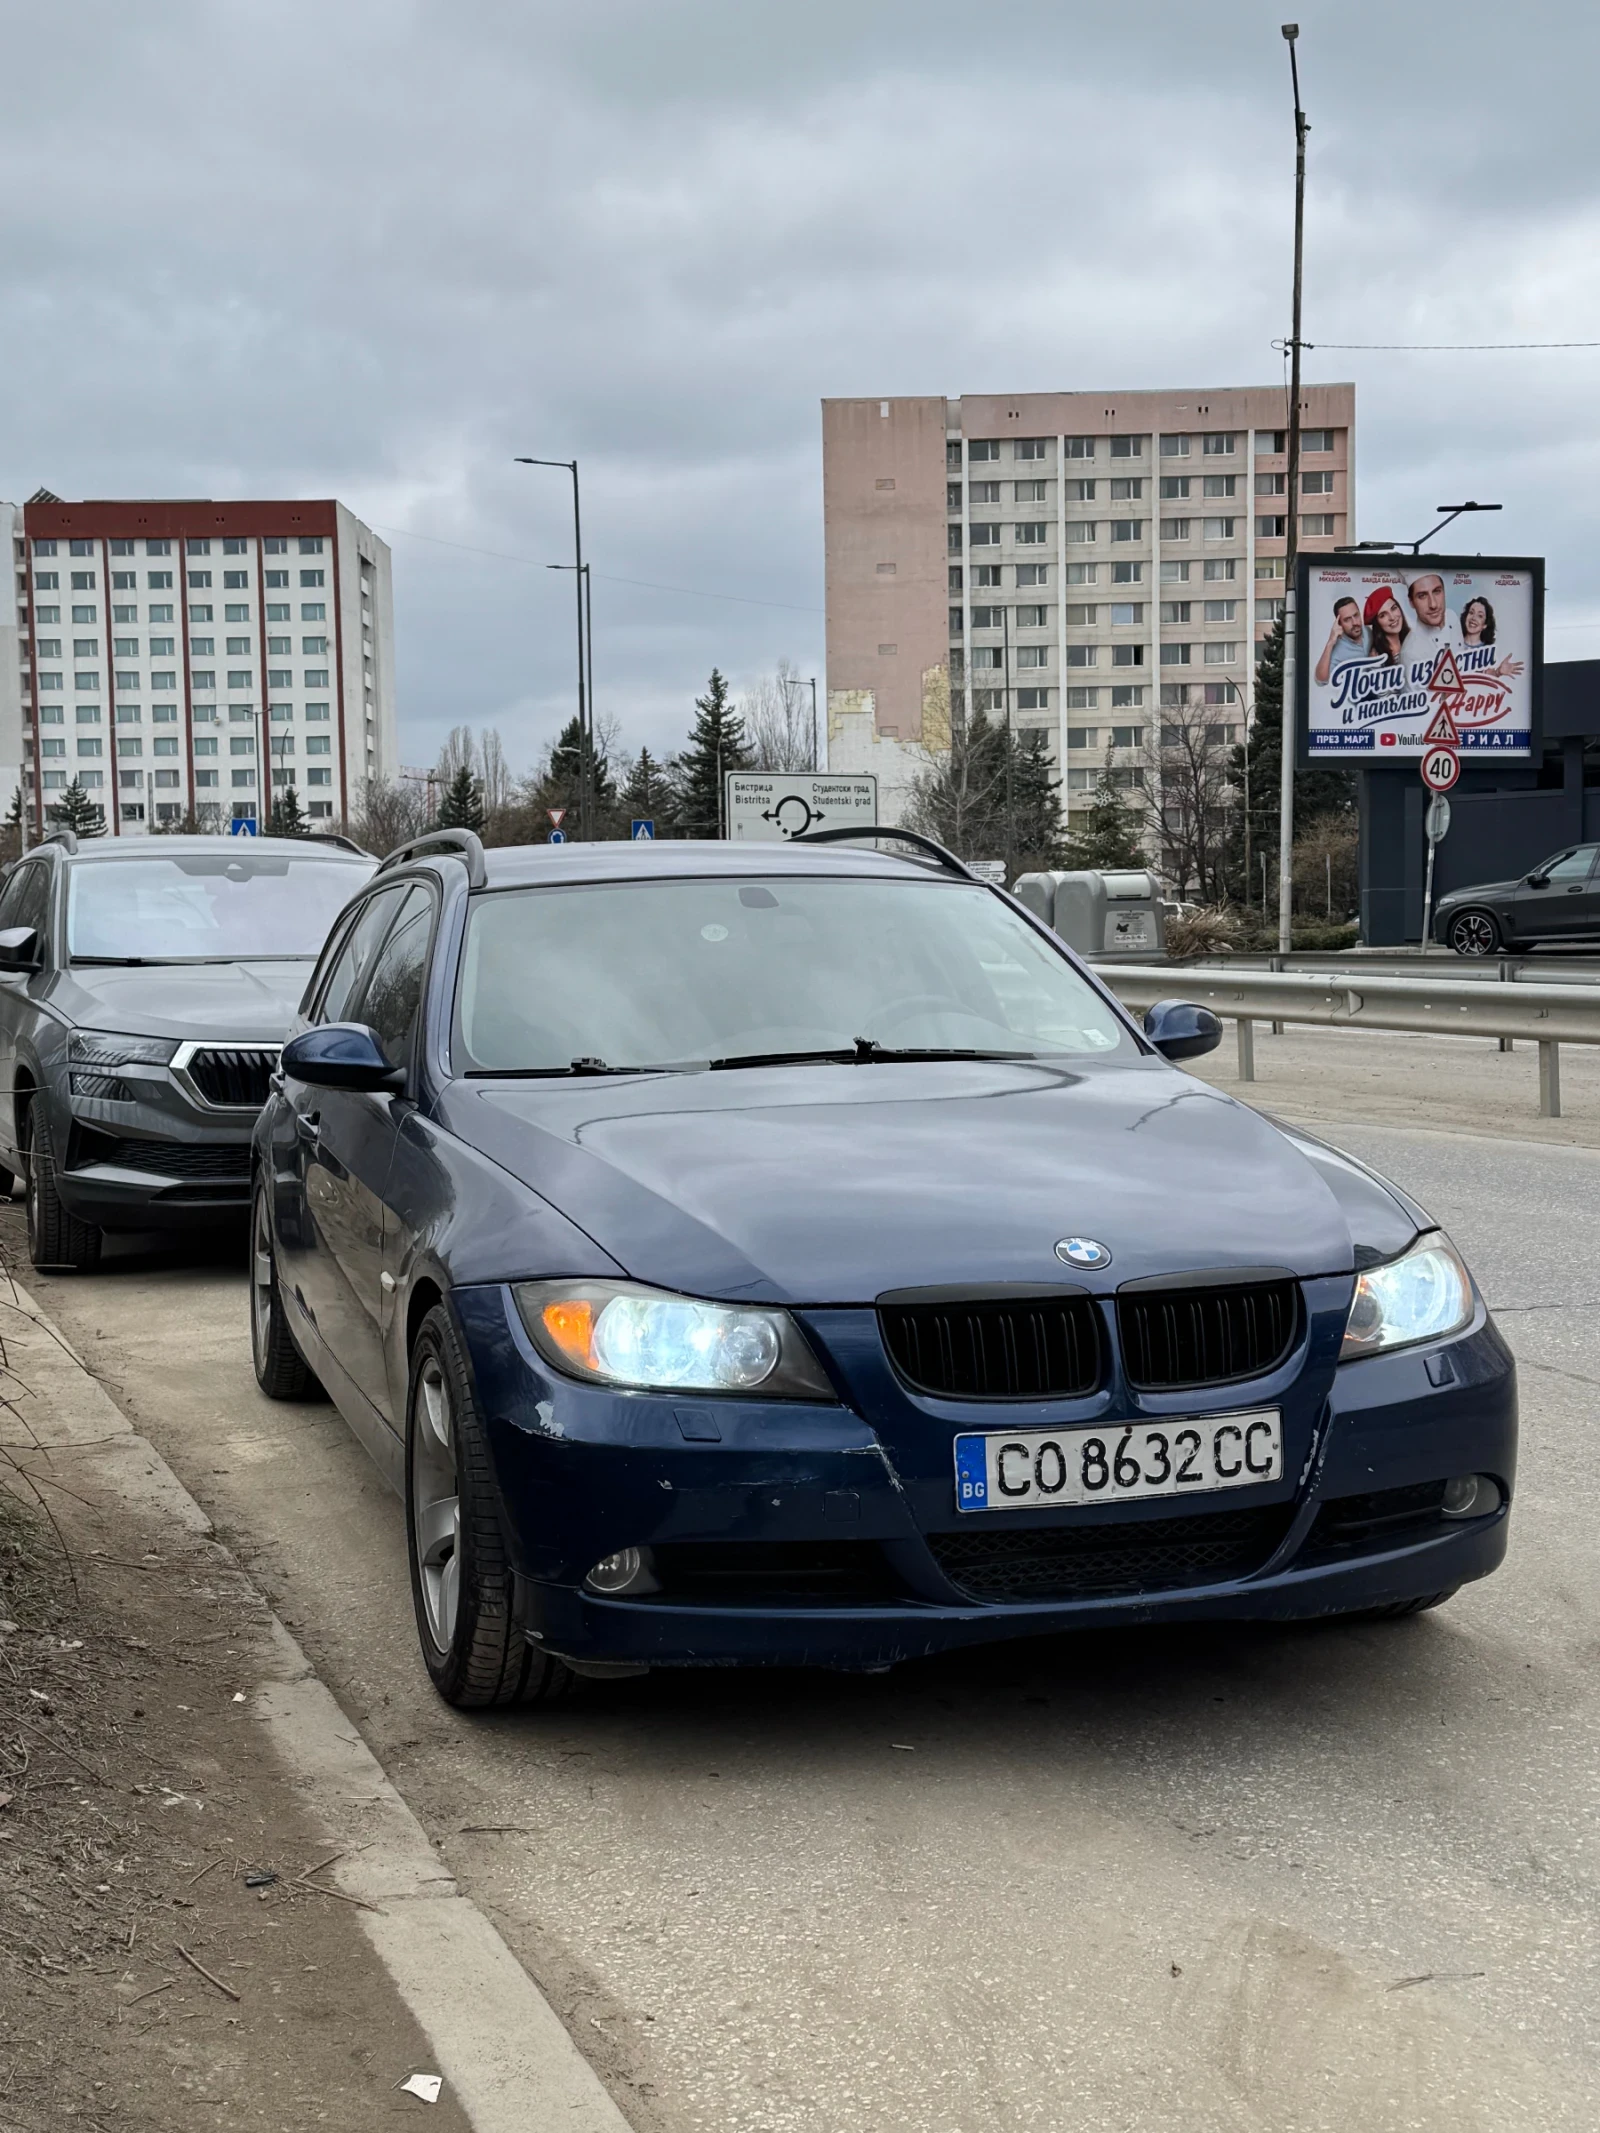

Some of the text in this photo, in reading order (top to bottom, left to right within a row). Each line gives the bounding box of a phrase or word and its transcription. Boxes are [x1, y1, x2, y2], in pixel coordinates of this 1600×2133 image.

[1331, 653, 1402, 709] Почти
[1342, 692, 1427, 725] и напълно
[1449, 690, 1506, 717] Happy
[1316, 735, 1370, 744] ПРЕЗ МАРТ
[1430, 757, 1452, 779] 40
[734, 782, 773, 793] Бистрица
[812, 783, 870, 794] Студентски град
[735, 795, 771, 804] Bistritsa
[812, 796, 871, 807] Studentski grad
[1080, 1429, 1204, 1491] 8632
[962, 1482, 985, 1499] BG
